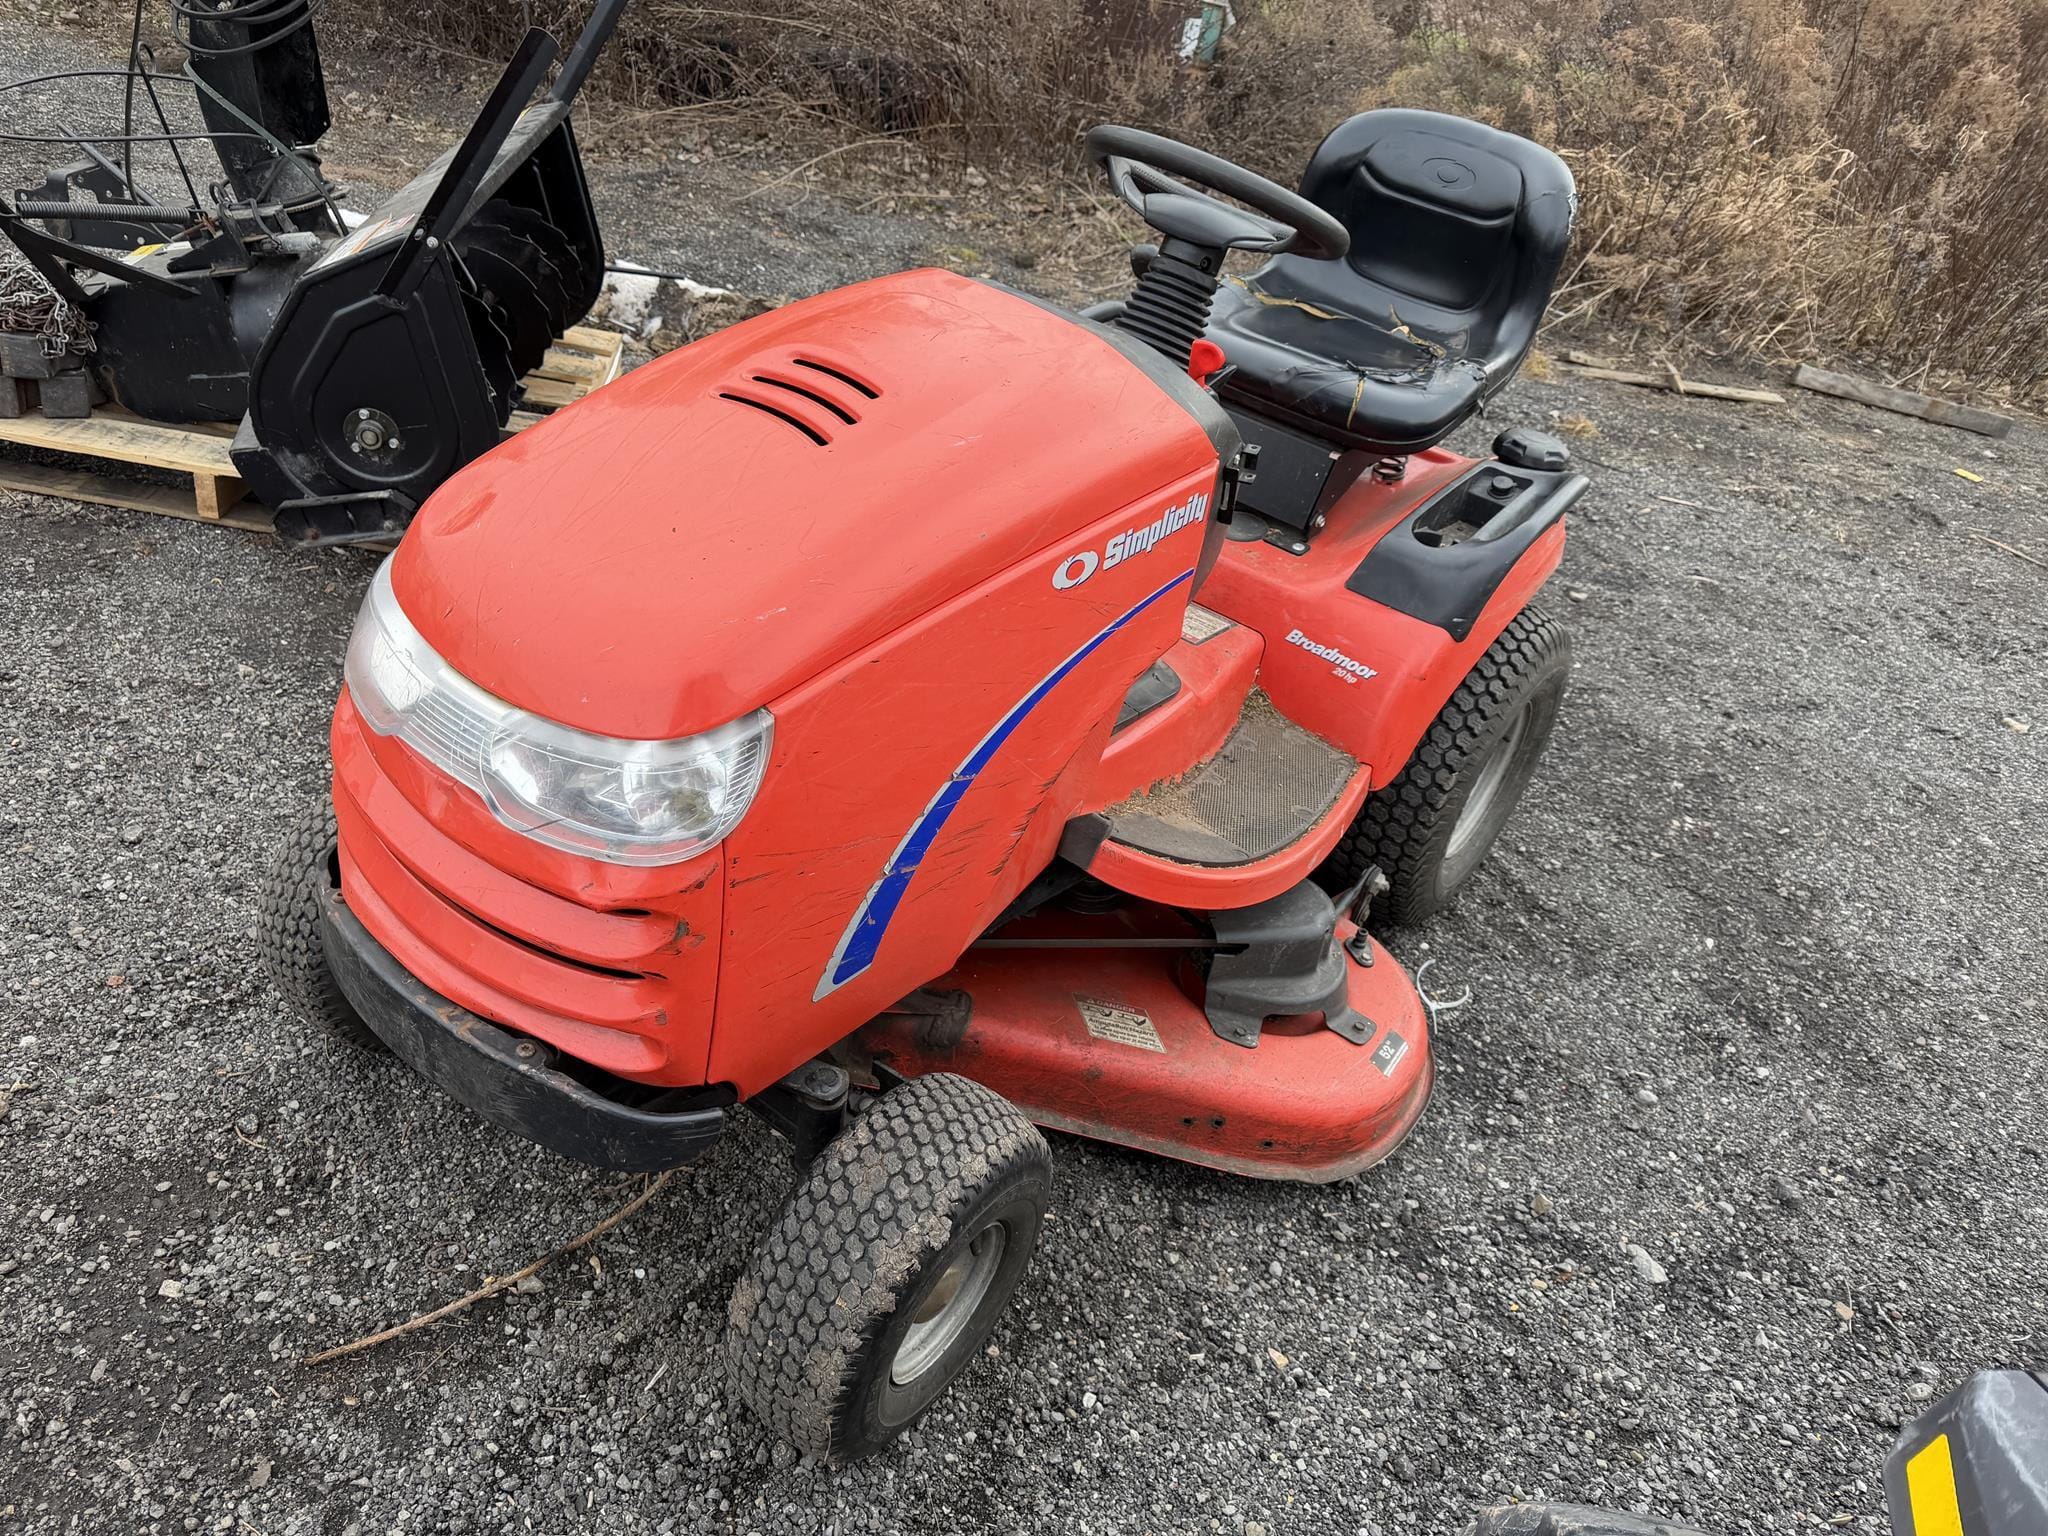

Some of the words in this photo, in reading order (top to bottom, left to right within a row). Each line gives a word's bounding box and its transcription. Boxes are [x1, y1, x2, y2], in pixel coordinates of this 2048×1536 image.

[1103, 493, 1209, 571] Simplicity
[1284, 628, 1378, 680] Broadmoor
[1331, 667, 1345, 678] 20
[1343, 672, 1358, 684] hp
[1096, 1000, 1135, 1014] DANGER
